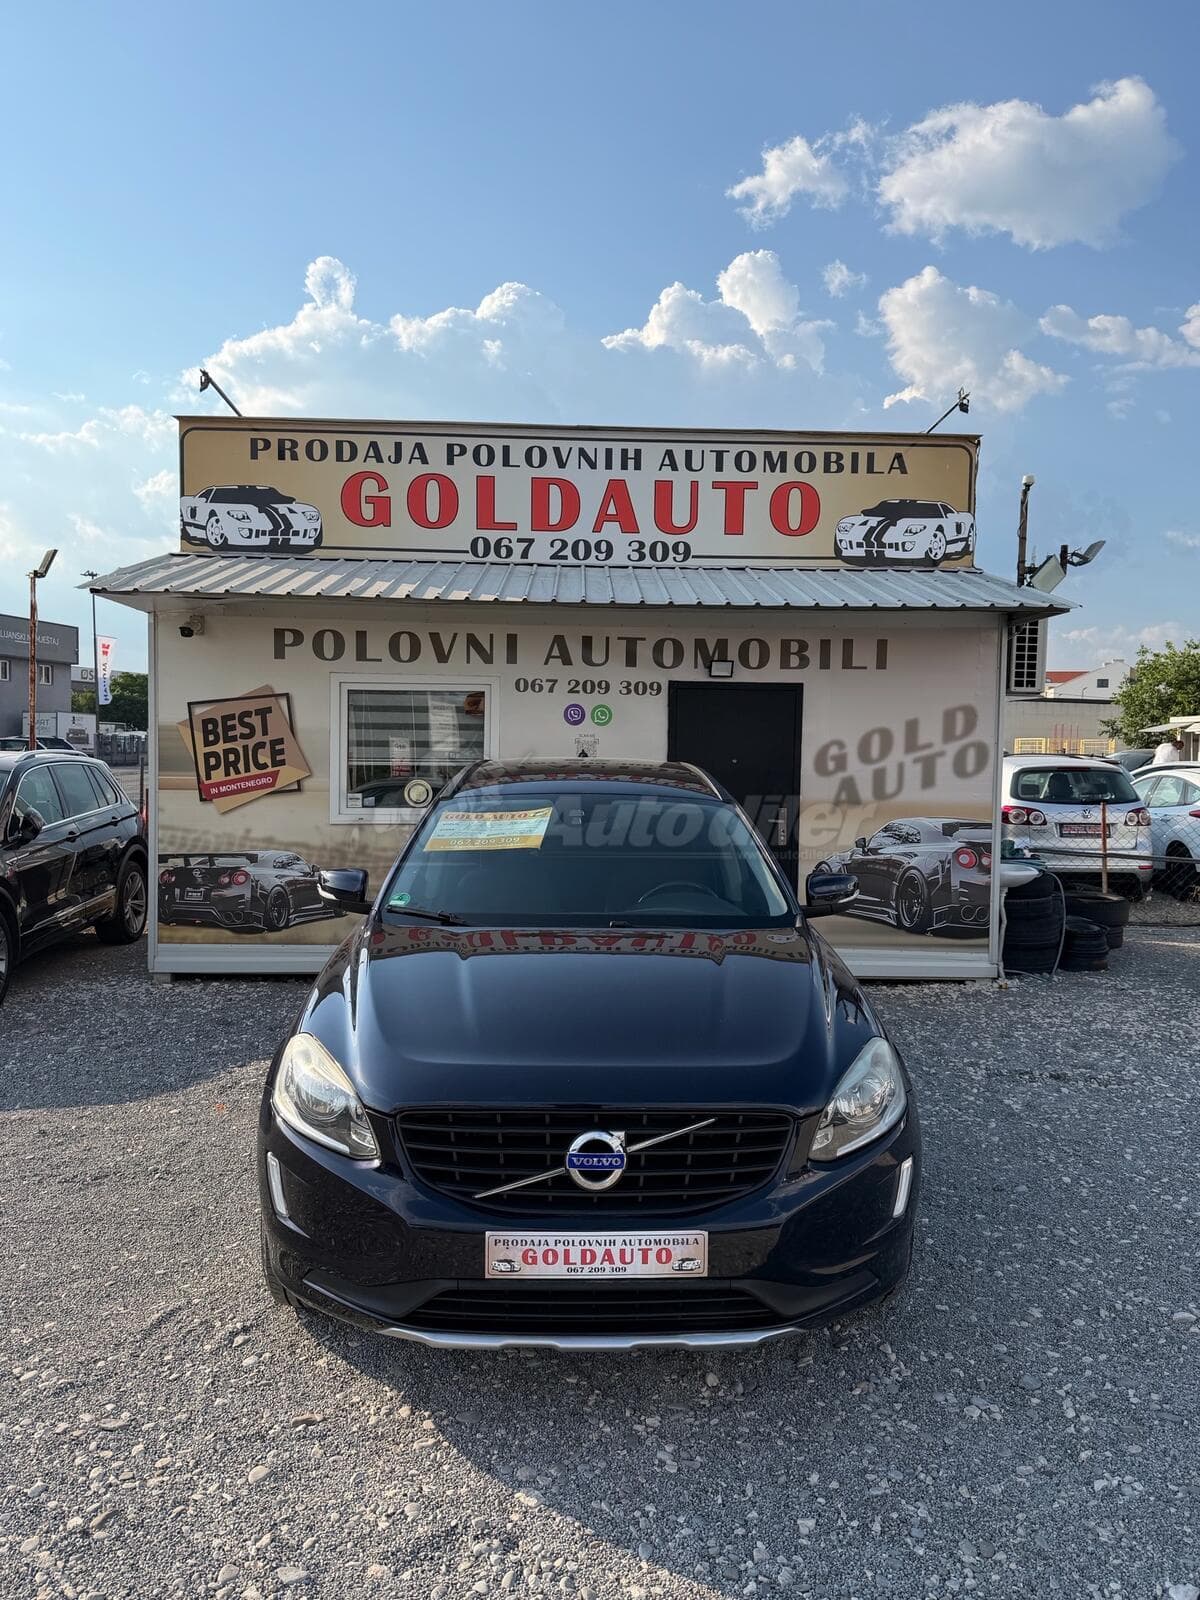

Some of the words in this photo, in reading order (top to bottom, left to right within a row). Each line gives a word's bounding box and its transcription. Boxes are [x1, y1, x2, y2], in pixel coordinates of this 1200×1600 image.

[250, 437, 429, 466] PRODAJA
[446, 442, 642, 471] POLOVNIH
[659, 448, 908, 475] AUTOMOBILA
[340, 470, 821, 537] GOLDAUTO
[470, 536, 535, 560] 067
[550, 538, 614, 562] 209
[627, 540, 692, 563] 309
[273, 627, 518, 665] POLOVNI
[543, 634, 888, 671] AUTOMOBILI
[514, 677, 558, 694] 067
[567, 679, 611, 695] 209
[619, 680, 662, 696] 309
[202, 706, 273, 748] BEST
[813, 703, 978, 778] GOLD
[203, 737, 286, 782] PRICE
[210, 787, 219, 795] IN
[219, 776, 273, 793] MONTENEGRO
[830, 740, 990, 812] AUTO
[490, 812, 529, 820] AUTO
[571, 1157, 621, 1166] VOLVO
[494, 1238, 550, 1247] PRODAJA
[554, 1238, 617, 1247] POLOVNIH
[620, 1237, 699, 1247] AUTOMOBILA
[521, 1247, 673, 1266] GOLDAUTO
